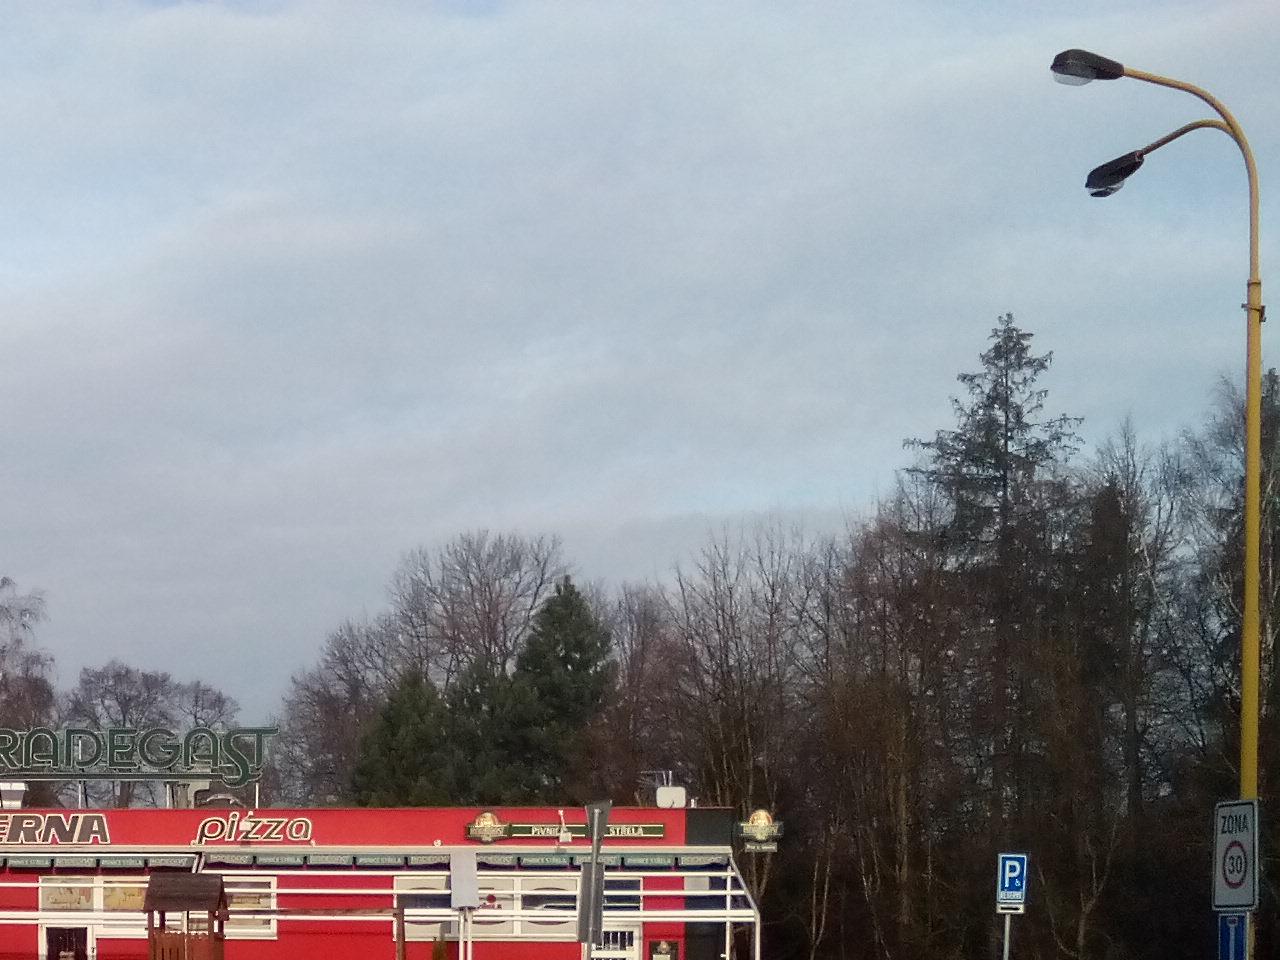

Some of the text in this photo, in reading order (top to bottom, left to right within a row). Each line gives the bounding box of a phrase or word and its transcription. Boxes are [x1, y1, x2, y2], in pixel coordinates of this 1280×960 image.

[196, 811, 312, 846] pizza
[1221, 814, 1249, 834] ZONA
[1004, 860, 1021, 888] P
[1228, 855, 1243, 874] 30
